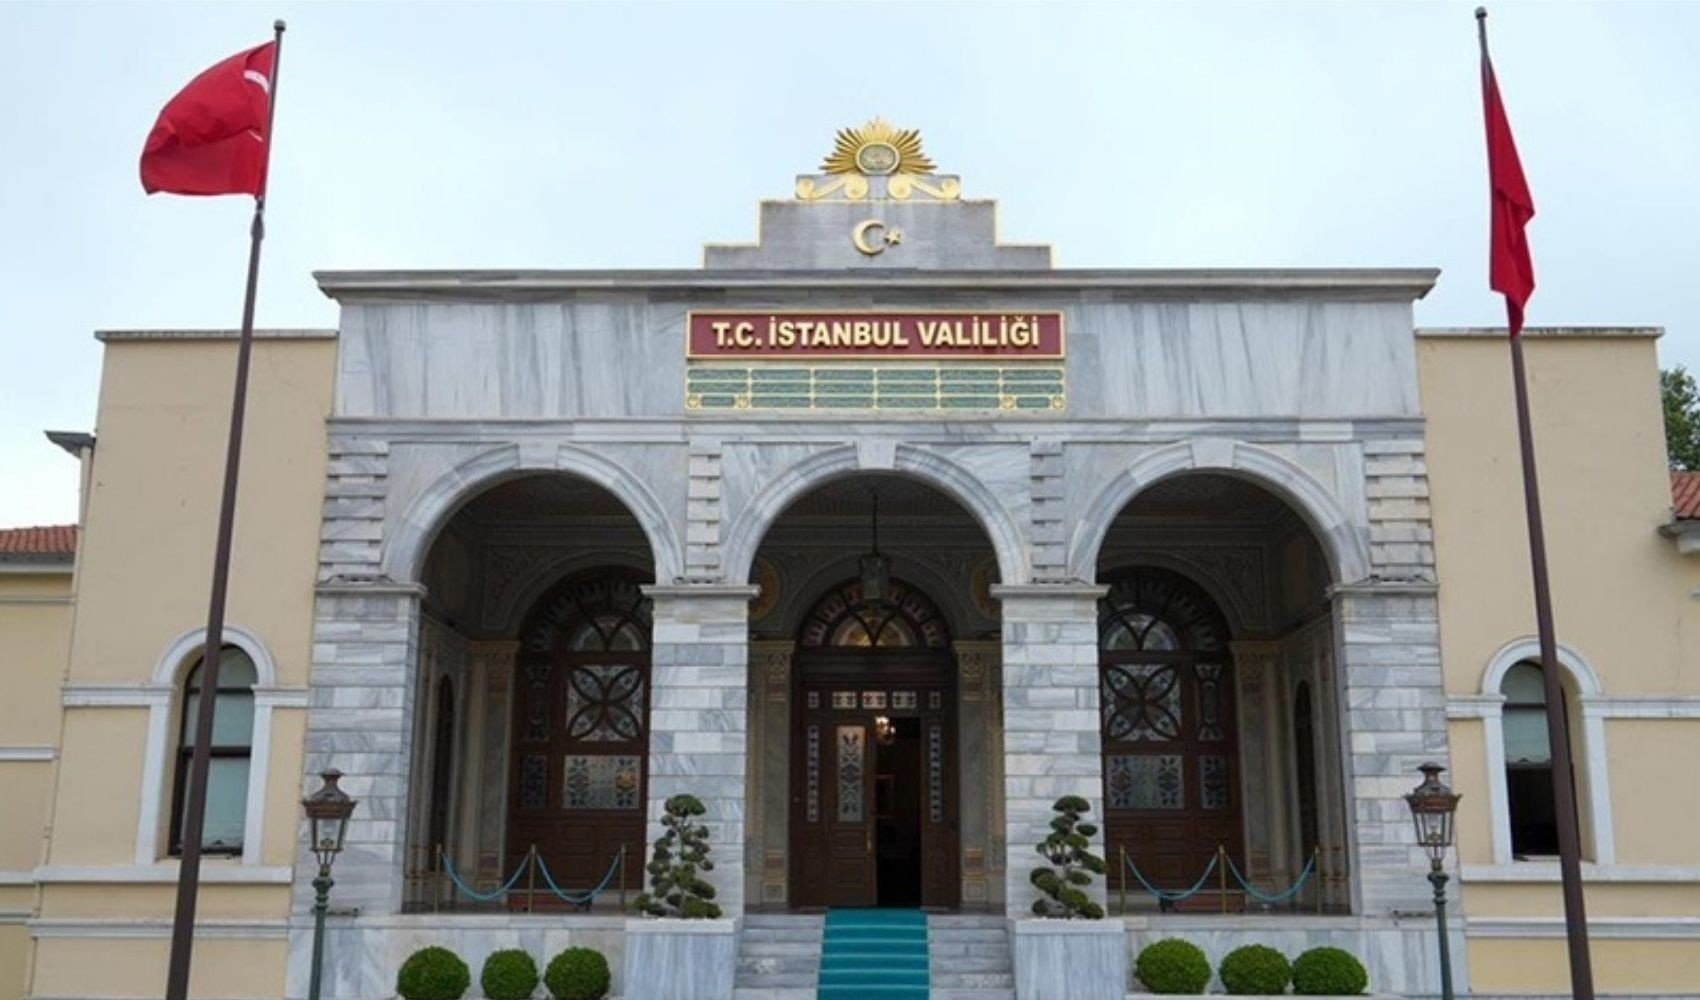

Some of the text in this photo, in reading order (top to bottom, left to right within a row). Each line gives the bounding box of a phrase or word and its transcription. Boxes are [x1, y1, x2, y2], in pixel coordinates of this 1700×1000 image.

[712, 316, 1040, 346] T.C. İSTANBUL VALİLİĞİ
